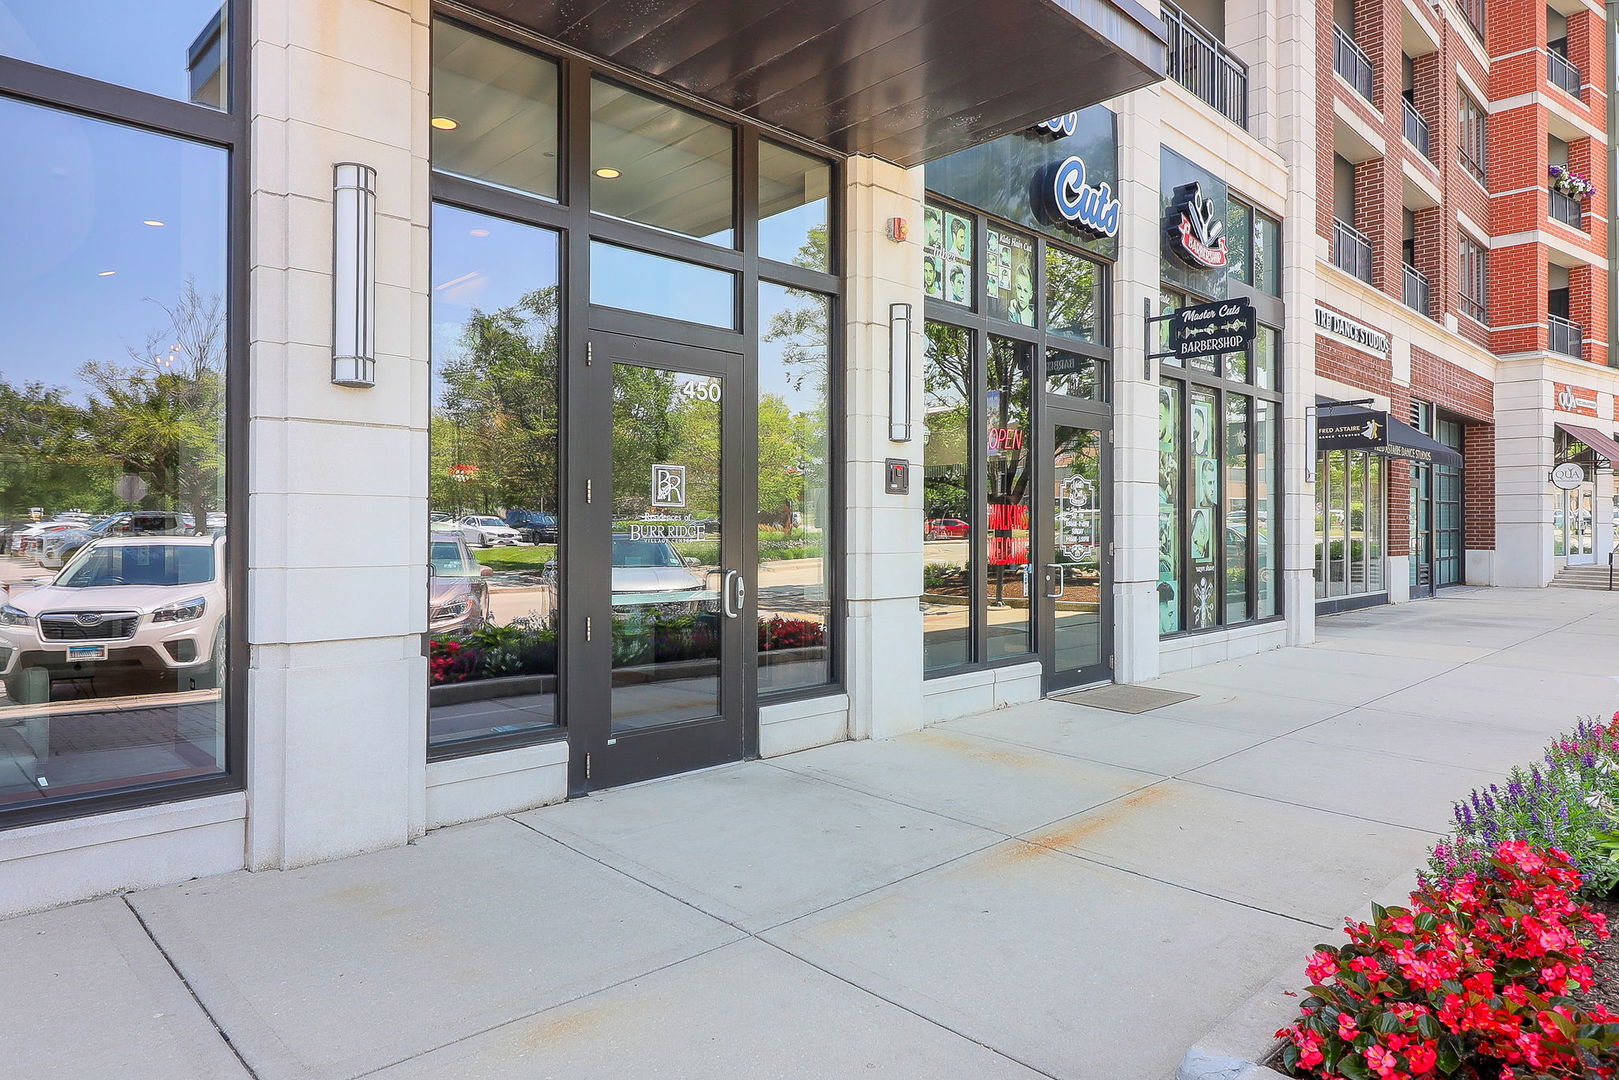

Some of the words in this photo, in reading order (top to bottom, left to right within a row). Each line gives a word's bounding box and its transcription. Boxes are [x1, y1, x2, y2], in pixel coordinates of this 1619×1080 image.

[1054, 155, 1121, 237] Cuts
[1181, 309, 1217, 323] Master
[1218, 304, 1241, 317] Cuts
[1333, 316, 1361, 342] DANCE
[1360, 328, 1389, 353] STUDIOS
[1181, 335, 1243, 354] BARBERSHOP
[683, 380, 722, 402] 450
[988, 427, 1023, 450] OPEN
[1334, 425, 1361, 433] ASTAIRE
[683, 513, 693, 522] of
[630, 524, 667, 541] BURR
[667, 524, 706, 541] RIDGE
